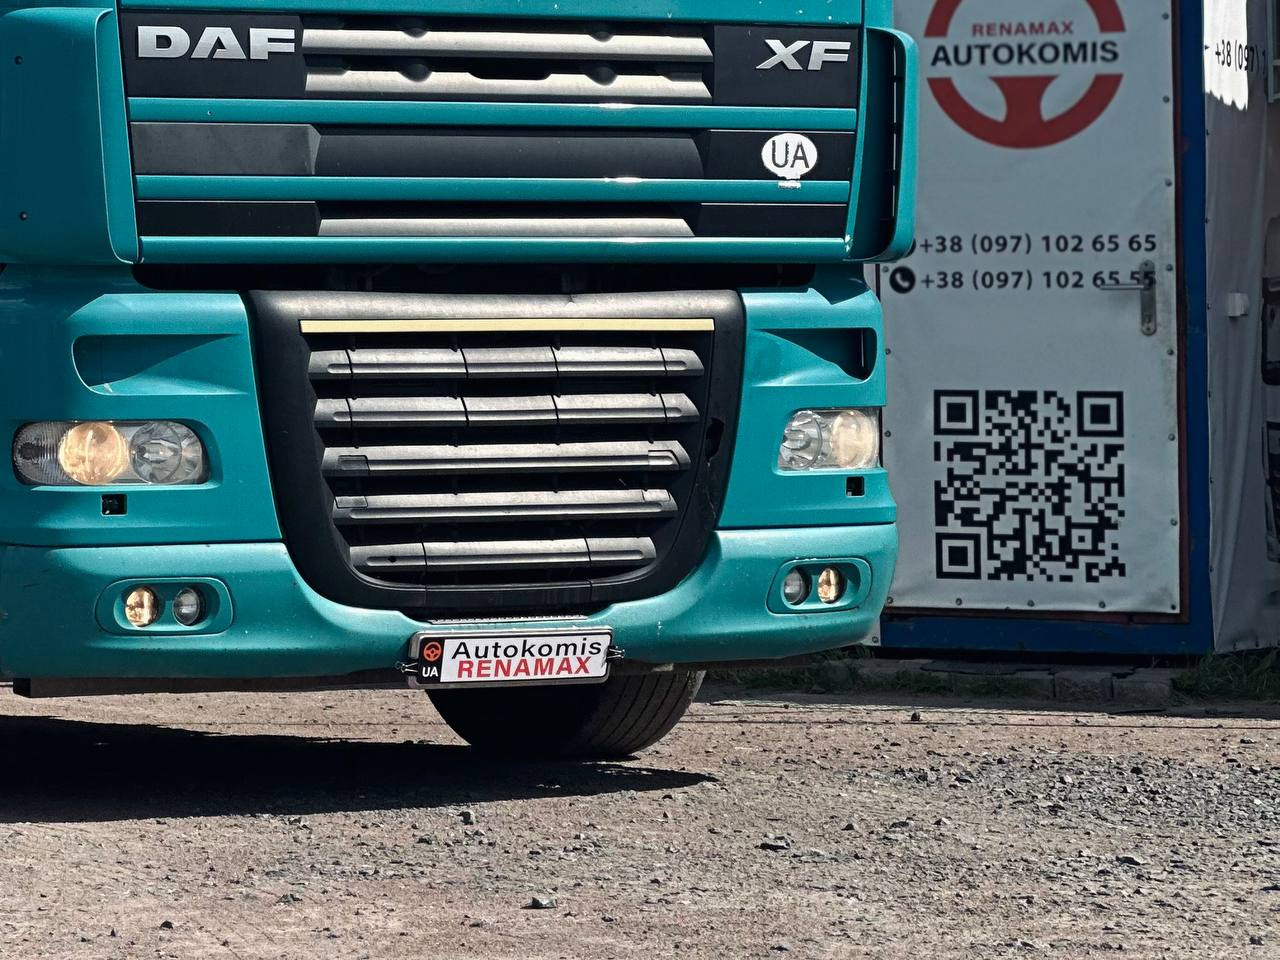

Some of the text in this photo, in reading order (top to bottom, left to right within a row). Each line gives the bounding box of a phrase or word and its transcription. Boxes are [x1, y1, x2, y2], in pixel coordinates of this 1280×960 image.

[971, 20, 1074, 38] RENAMAX
[137, 25, 296, 60] DAF
[930, 40, 1120, 68] AUTOKOMIS
[755, 39, 852, 71] XF
[771, 140, 810, 168] UA
[920, 233, 1157, 255] +38 (097) 102 65 65
[920, 271, 964, 289] +38
[972, 269, 1033, 291] (097)
[1042, 271, 1084, 289] 102
[1092, 271, 1120, 289] 65
[451, 637, 602, 660] Autokomis
[422, 666, 439, 678] UA
[456, 655, 593, 679] RENAMAX
